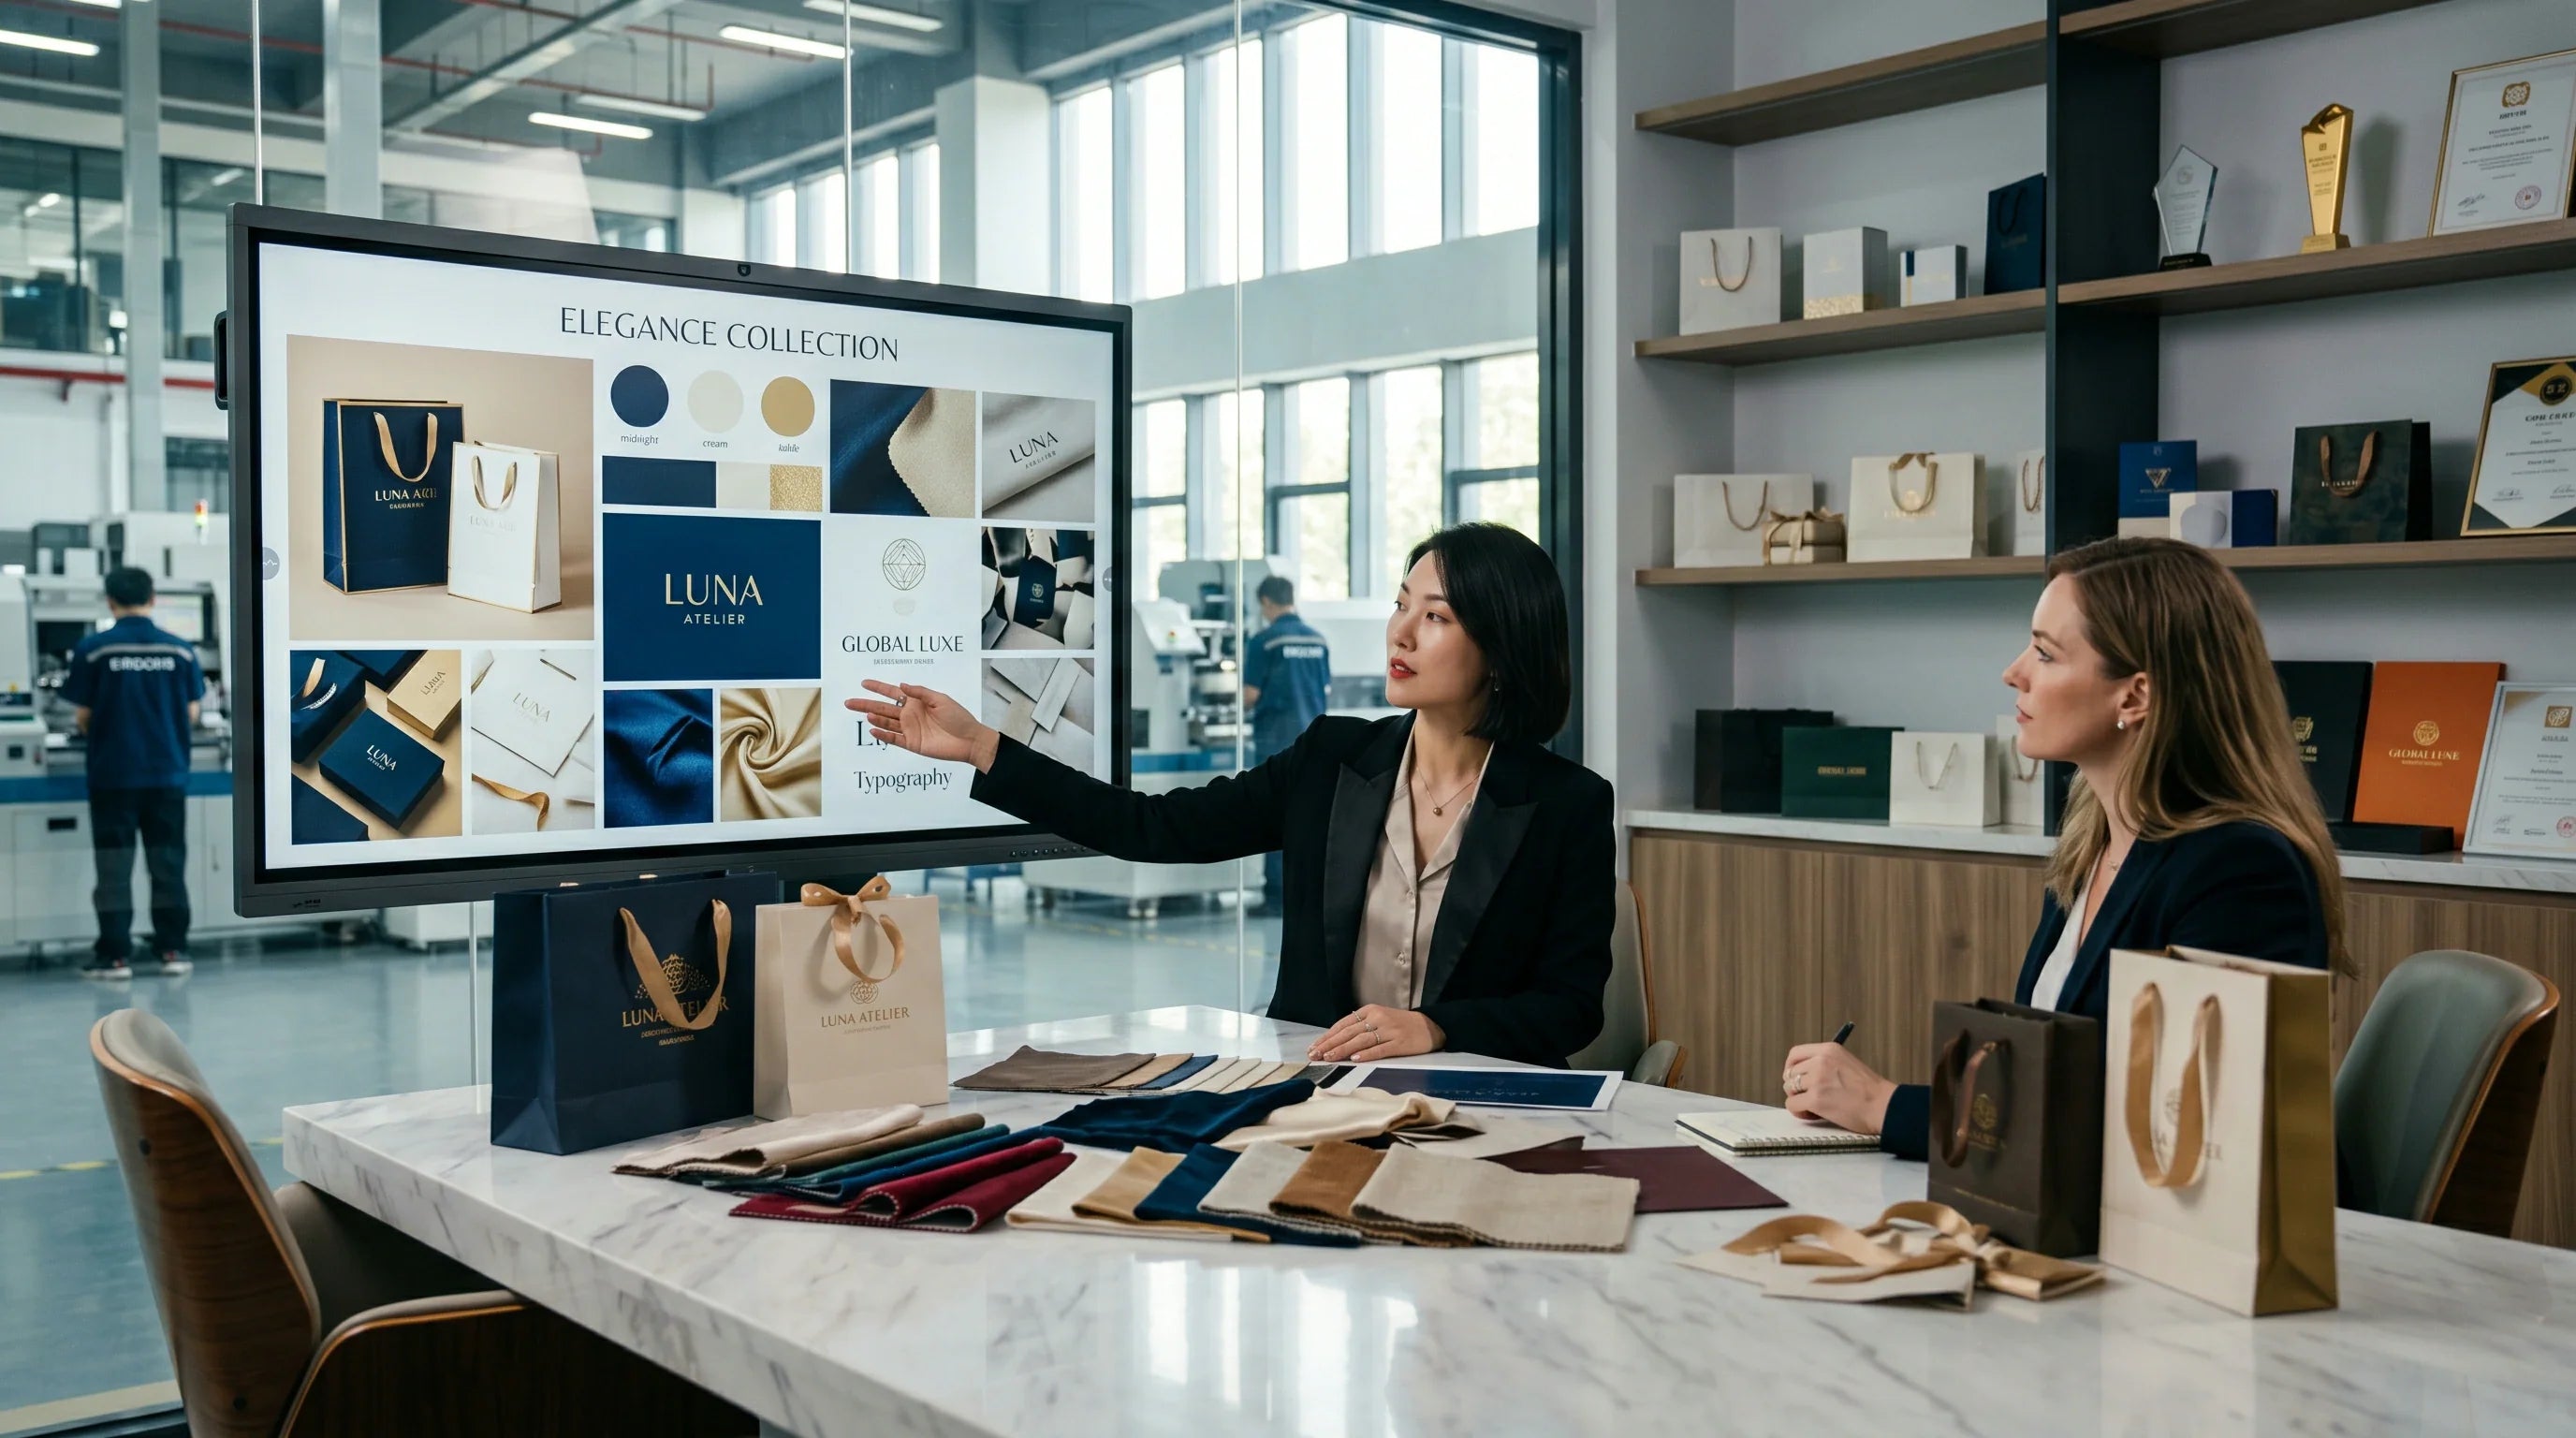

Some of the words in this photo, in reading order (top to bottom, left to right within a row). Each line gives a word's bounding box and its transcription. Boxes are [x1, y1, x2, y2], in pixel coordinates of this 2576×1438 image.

[562, 306, 718, 346] ELEGANCE
[726, 322, 899, 362] COLLECTION
[702, 439, 728, 448] cream
[1009, 431, 1059, 463] LUNA
[374, 489, 409, 502] LUNA
[666, 573, 764, 606] LUNA
[683, 613, 745, 625] ATELIER
[842, 635, 915, 653] GLOBAL
[920, 635, 964, 653] LUXE
[513, 692, 550, 723] LUNA
[367, 744, 397, 770] LUNA
[854, 767, 953, 795] Typography
[622, 1008, 665, 1028] LUNA
[821, 1013, 856, 1028] LUNA
[859, 1006, 910, 1023] ATELIER
